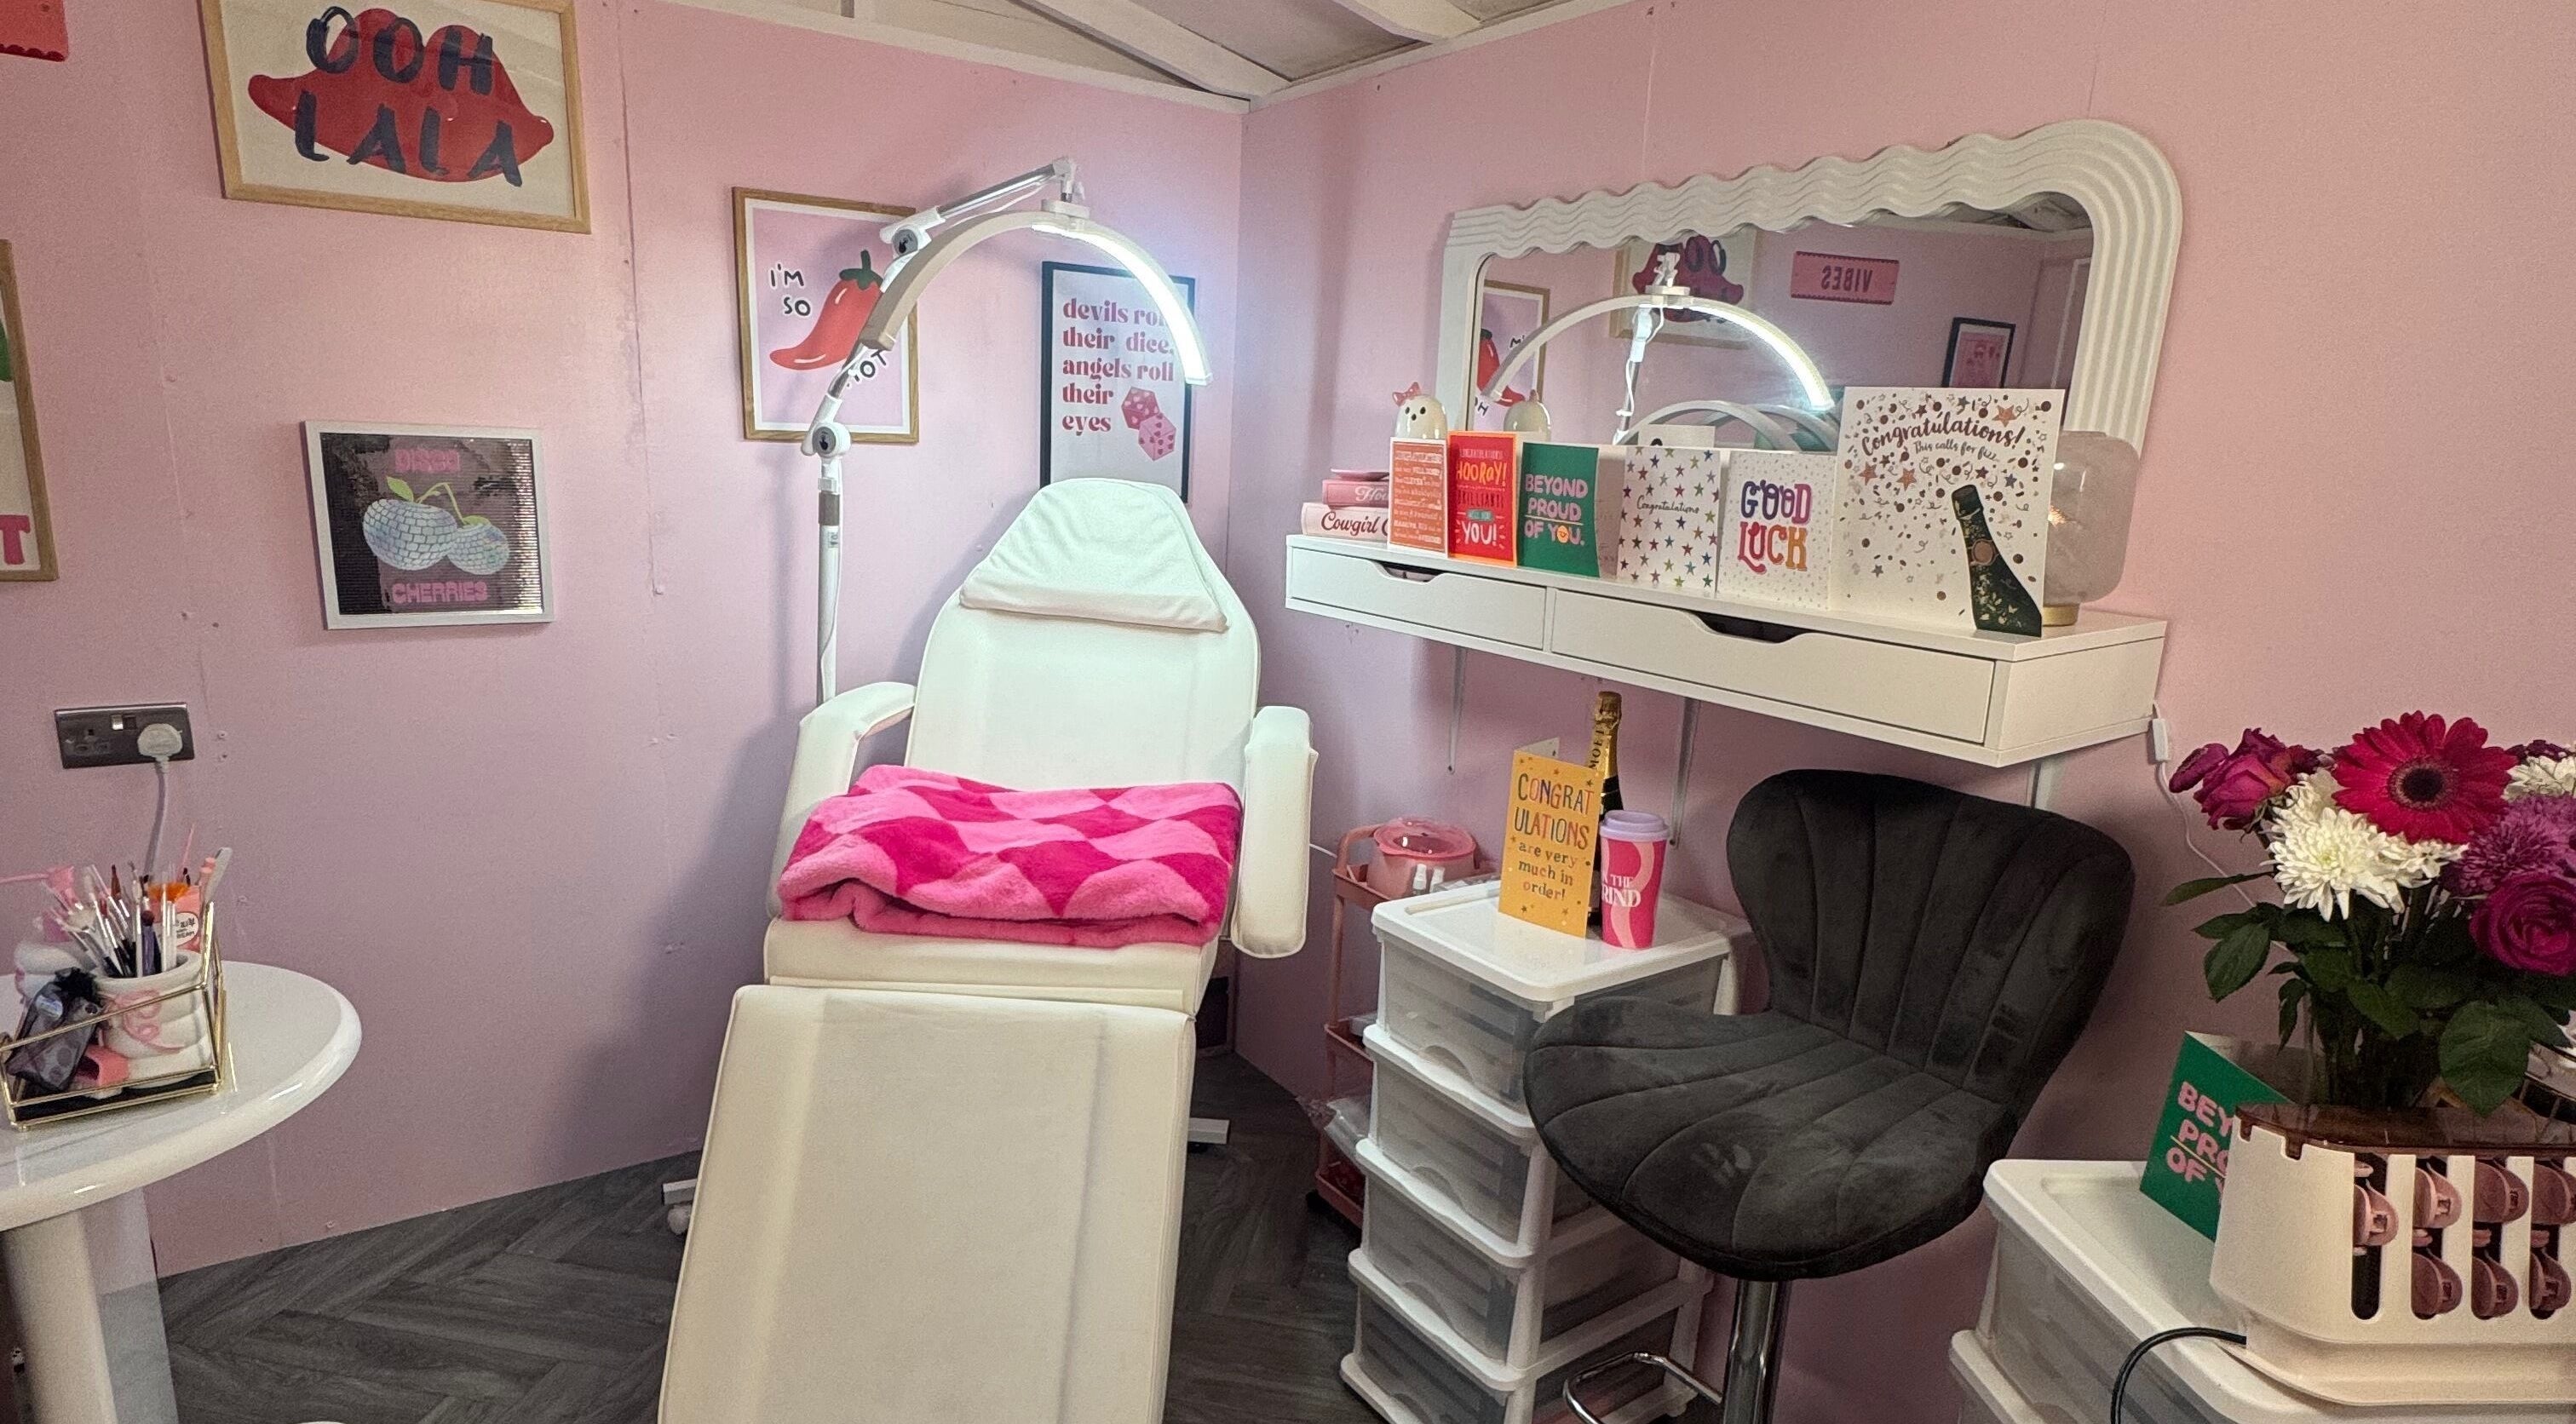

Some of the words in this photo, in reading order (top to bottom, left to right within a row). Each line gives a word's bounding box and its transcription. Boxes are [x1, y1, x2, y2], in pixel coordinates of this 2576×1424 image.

[306, 6, 496, 95] OOH
[295, 90, 522, 187] LALA
[771, 263, 804, 287] I'M
[783, 296, 811, 316] SO
[1063, 298, 1129, 323] devils
[1134, 309, 1165, 326] ro
[1063, 326, 1115, 349] their
[847, 349, 887, 387] OT
[1063, 358, 1132, 381] angels
[1137, 361, 1174, 382] roll
[1062, 382, 1114, 405] their
[1062, 415, 1112, 436] eyes
[1861, 411, 2026, 456] Congratulations!
[1914, 439, 1933, 455] This
[1935, 439, 1958, 452] calls
[1961, 441, 1976, 456] for
[1525, 474, 1589, 498] BEYOND
[1527, 497, 1582, 521] PROUD
[1740, 479, 1812, 525] GOOD
[1321, 511, 1381, 537] Cowgirl
[1461, 520, 1498, 547] YOU!
[1524, 520, 1544, 538] OF
[1737, 521, 1808, 575] LUCK
[392, 580, 489, 604] CHERRIES
[1518, 773, 1595, 815] CONGRAT
[1515, 807, 1590, 850] ULATIONS
[1519, 841, 1542, 857] are
[1545, 850, 1578, 869] very
[1519, 860, 1555, 880] much
[1561, 870, 1573, 887] in
[1610, 873, 1634, 888] THE
[1522, 881, 1566, 901] order!
[1601, 883, 1642, 908] RIND
[2177, 1081, 2234, 1137] BEY
[2178, 1119, 2229, 1174] PRO
[2166, 1146, 2208, 1182] OF
